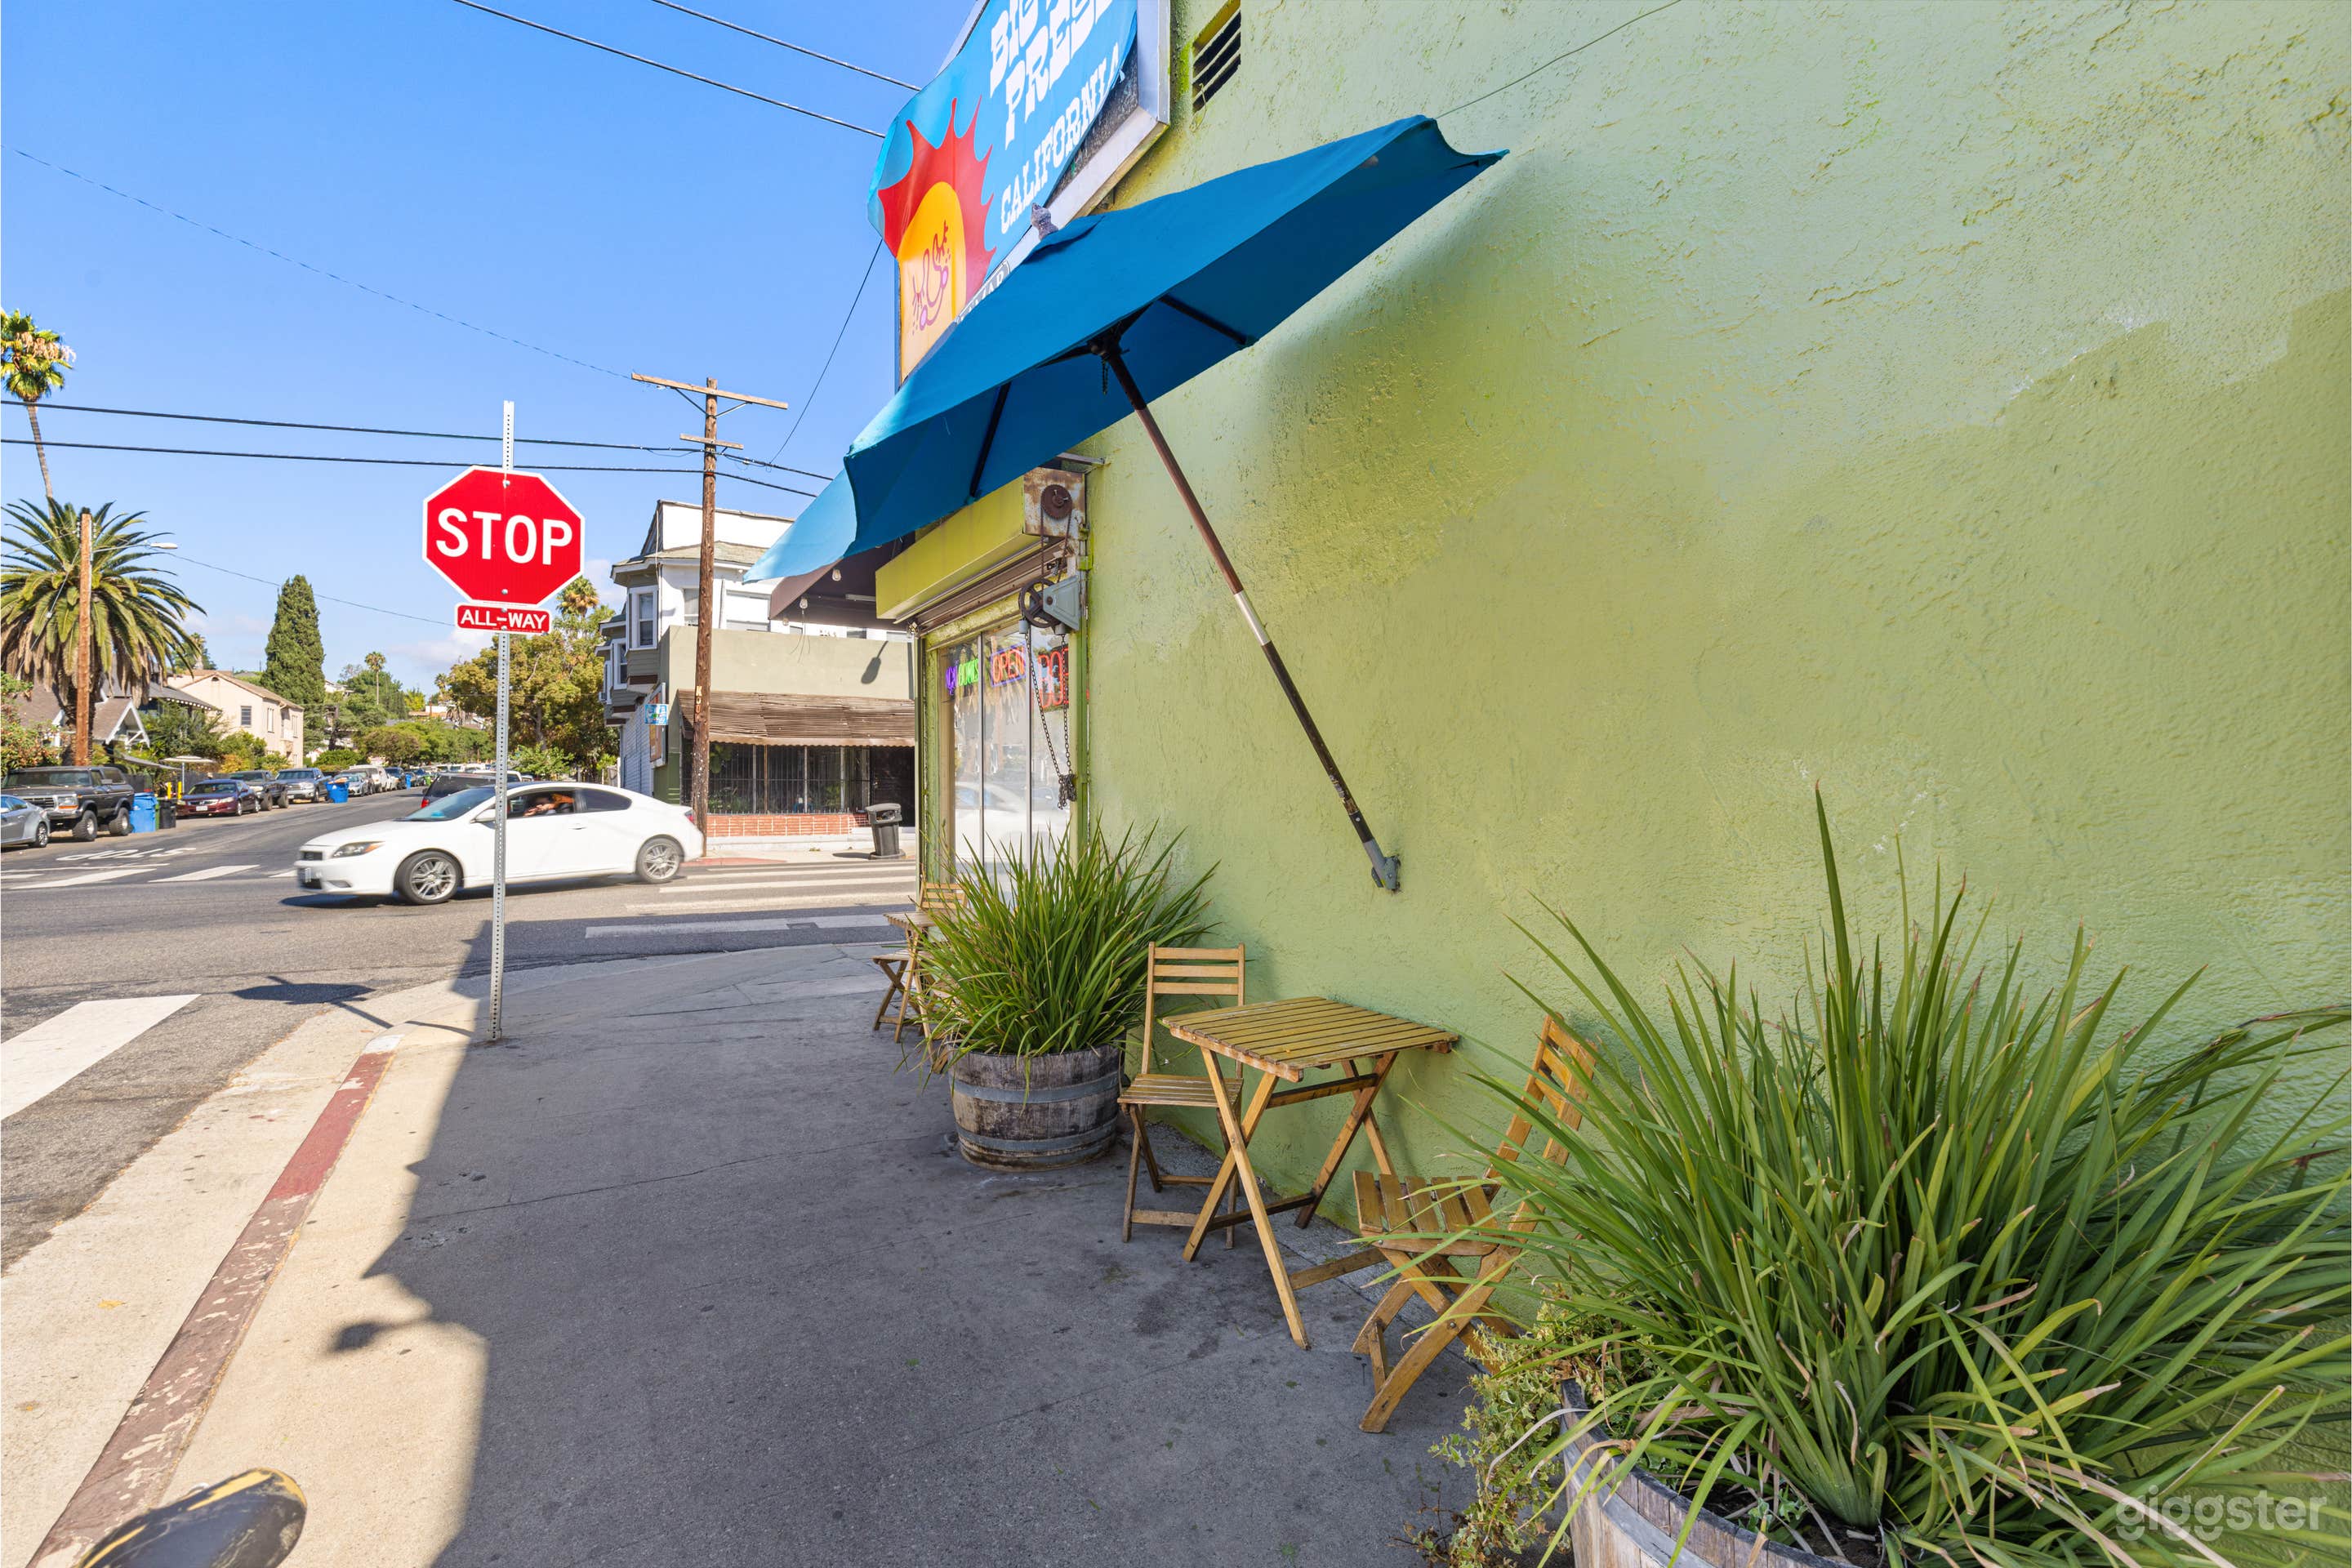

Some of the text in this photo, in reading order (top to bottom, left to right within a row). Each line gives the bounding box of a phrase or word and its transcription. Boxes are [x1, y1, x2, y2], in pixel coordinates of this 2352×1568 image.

[1006, 0, 1113, 150] PRES
[1001, 42, 1120, 234] CALIFORNIA
[436, 508, 573, 565] STOP
[460, 609, 547, 630] ALL-WAY
[993, 646, 1025, 684] OPEN
